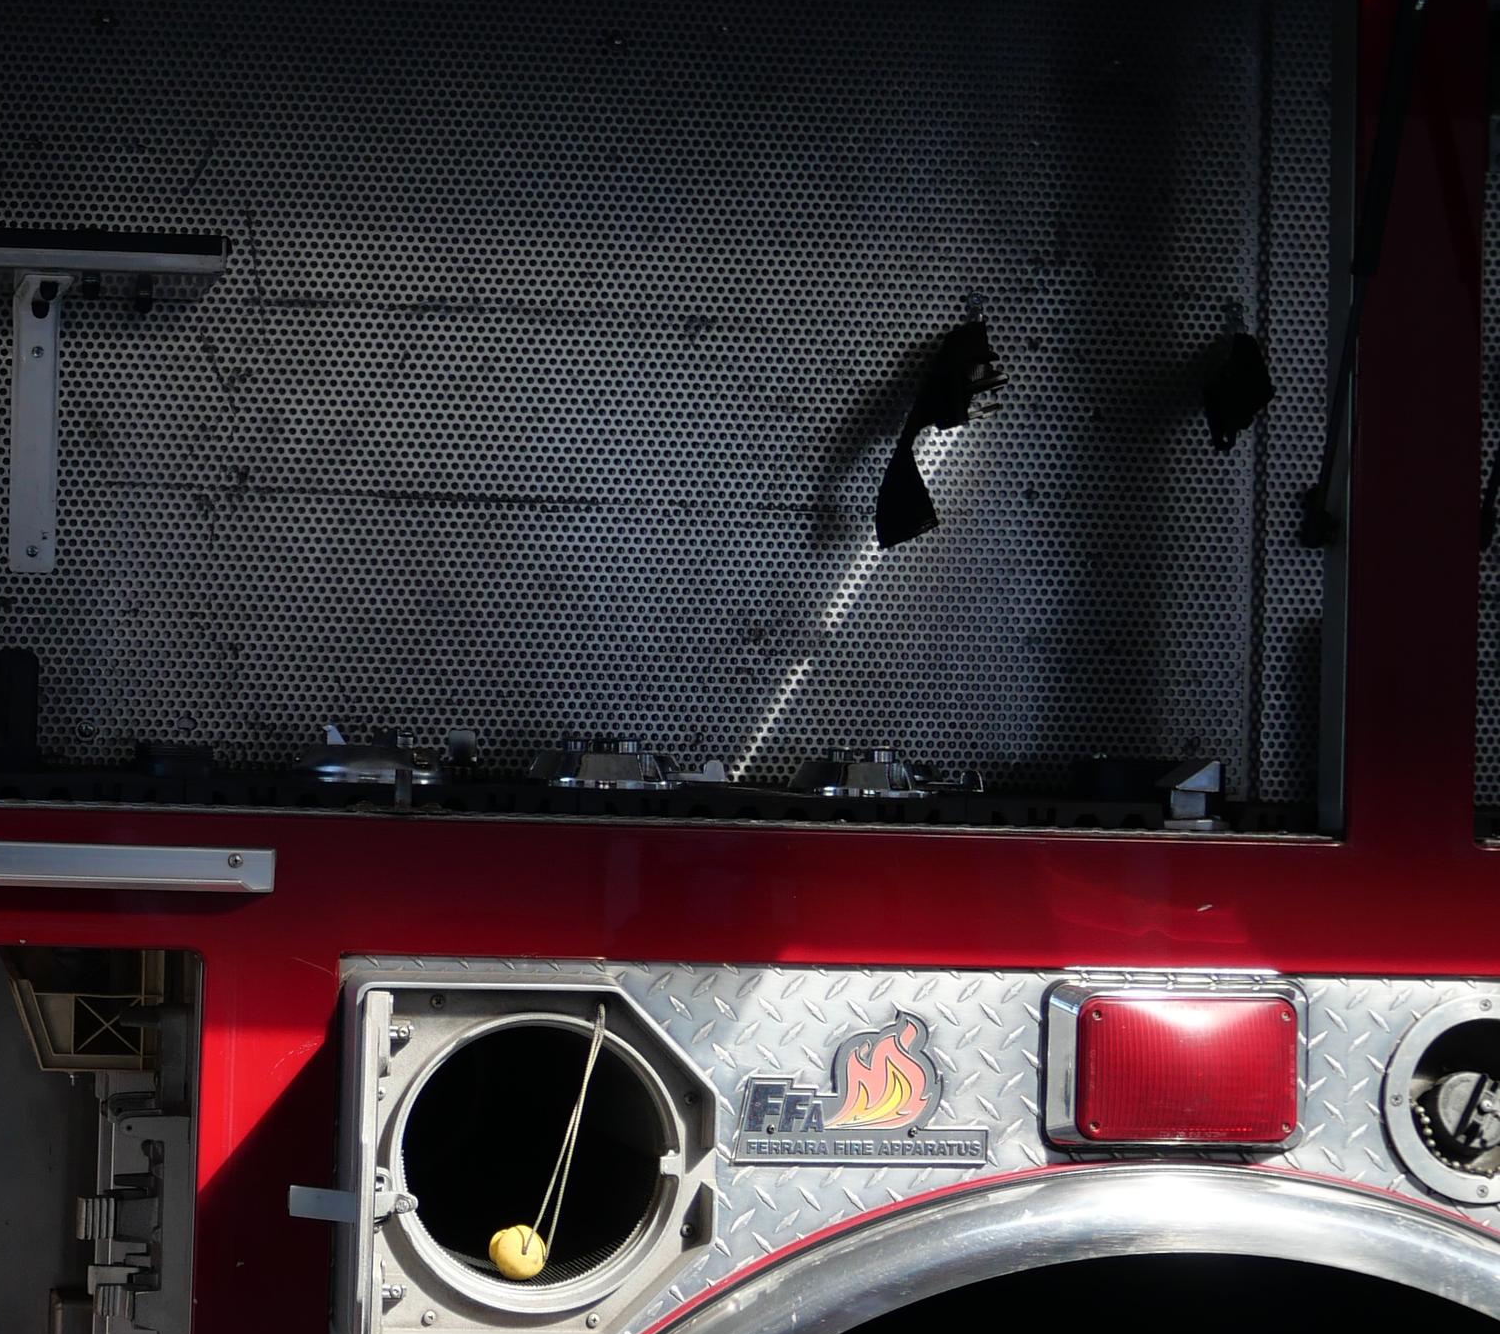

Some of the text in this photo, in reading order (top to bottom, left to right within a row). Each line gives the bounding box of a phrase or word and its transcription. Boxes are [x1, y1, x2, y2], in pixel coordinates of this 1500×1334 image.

[744, 1081, 825, 1133] FFA
[745, 1138, 982, 1157] FERRARA FIRE APPARATUS
